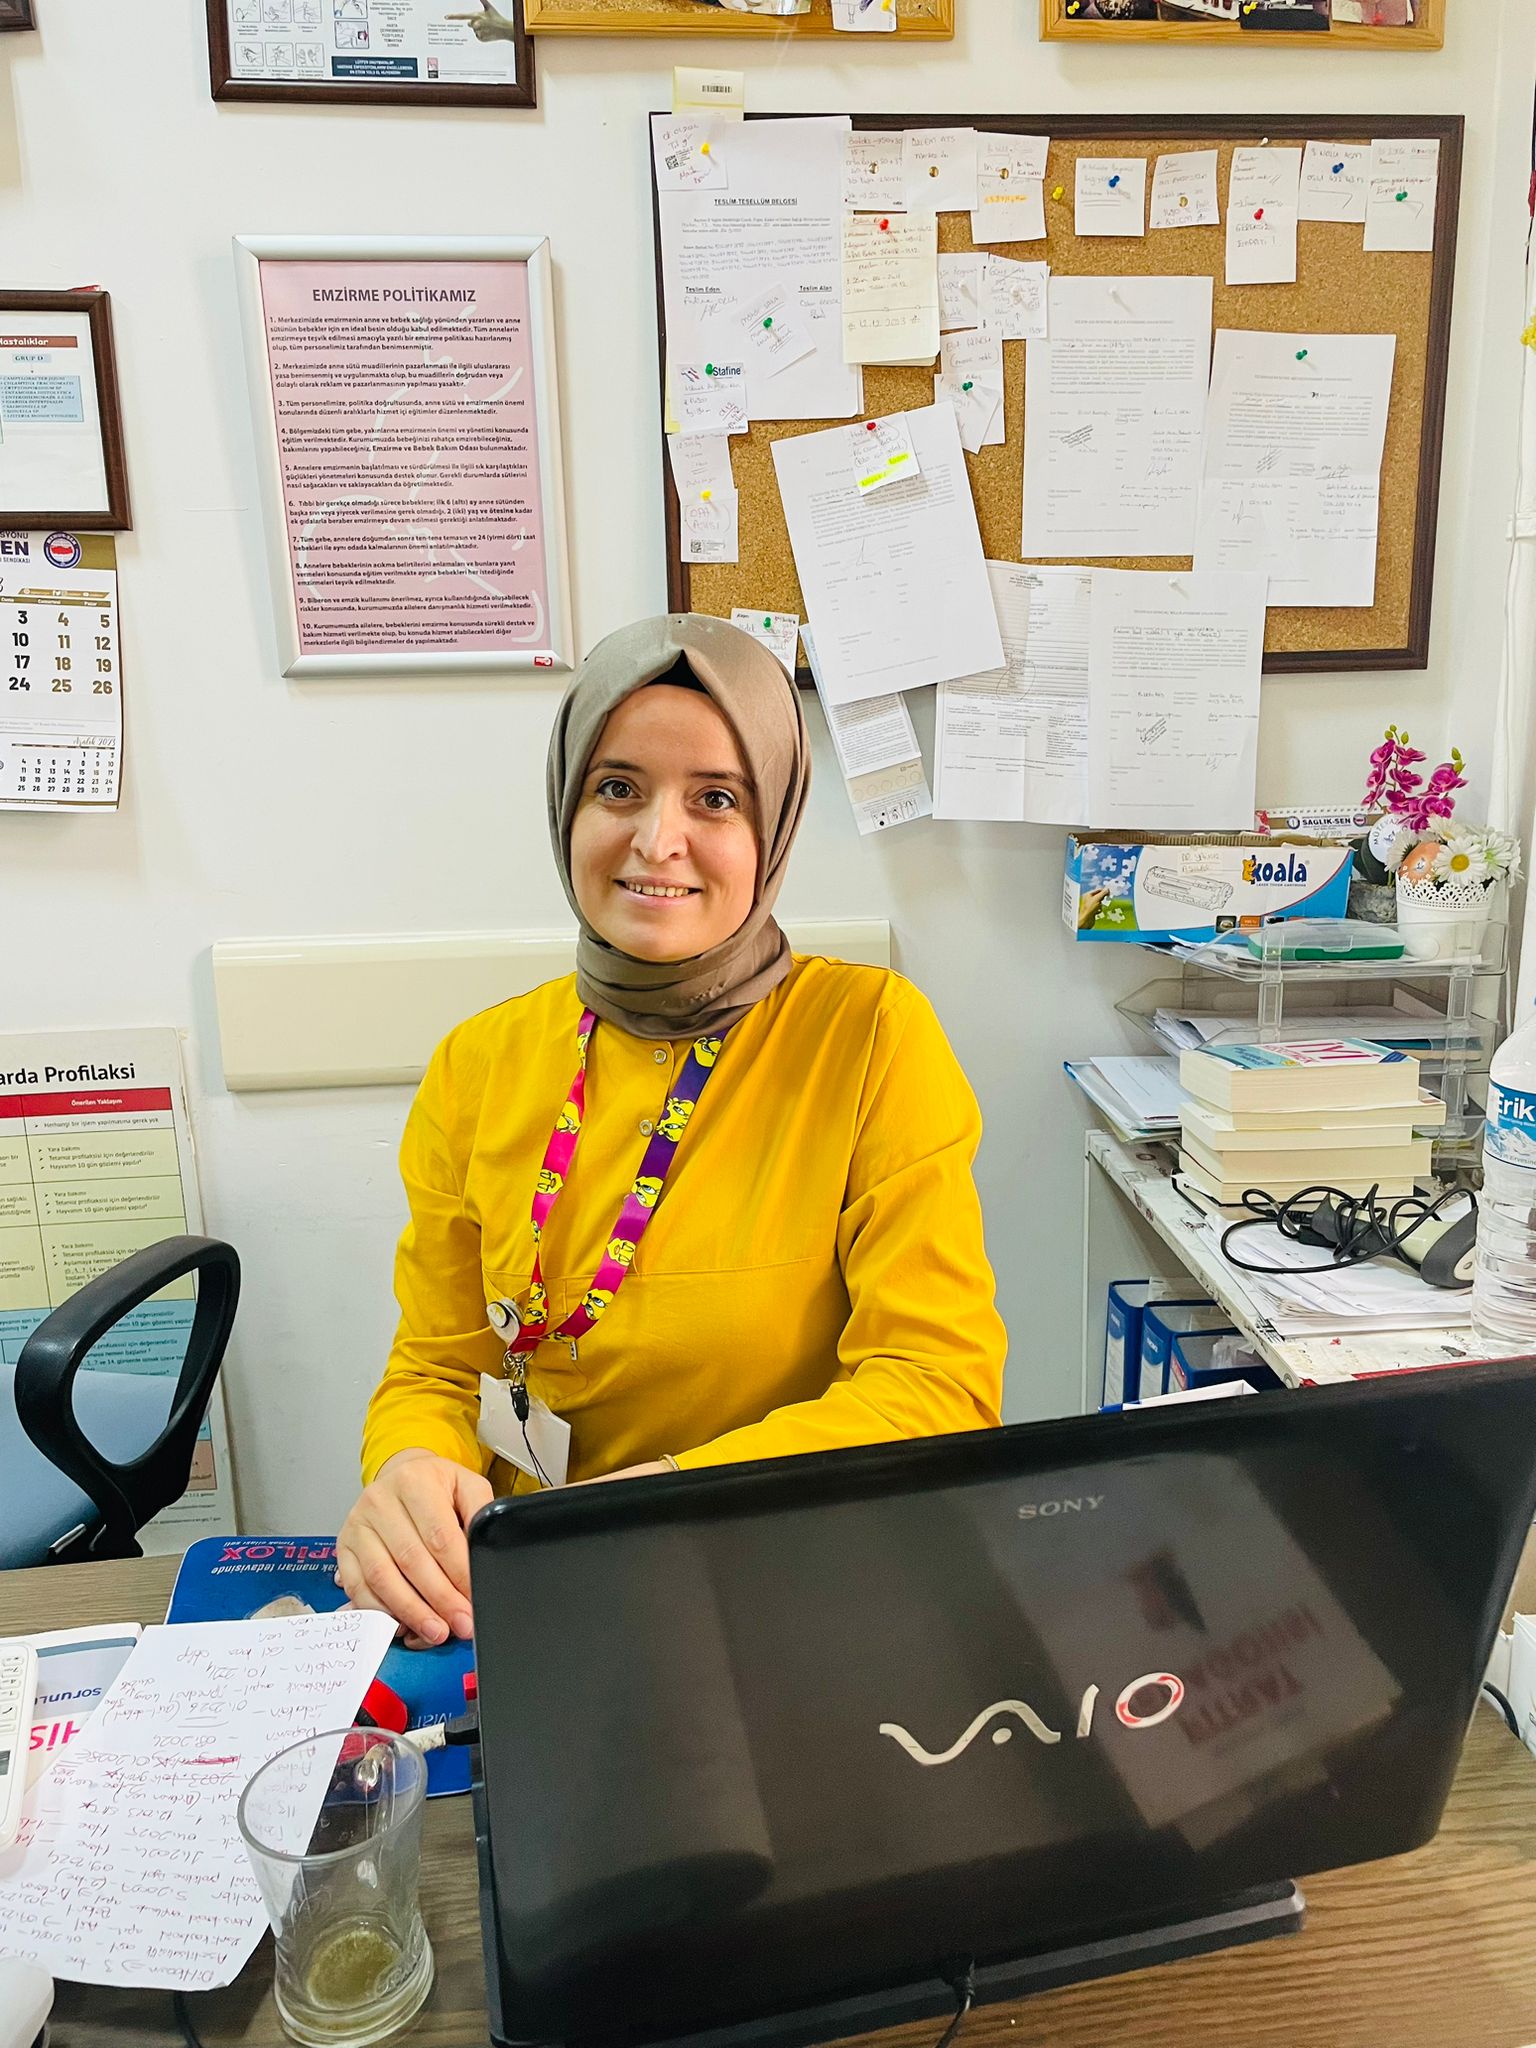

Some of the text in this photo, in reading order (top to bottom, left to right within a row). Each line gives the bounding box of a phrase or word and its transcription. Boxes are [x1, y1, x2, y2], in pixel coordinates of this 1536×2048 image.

[313, 286, 476, 302] EMZİRME POLİTİKAMIZ
[712, 366, 741, 377] Stafine
[18, 610, 110, 628] 3 4 5
[12, 633, 111, 650] 10 11 12
[14, 655, 112, 672] 17 18 19
[9, 677, 113, 695] 24 25 26
[44, 1063, 136, 1082] Profilaksi
[71, 1098, 123, 1107] Önerilen Yaklaşım
[1017, 1495, 1105, 1520] SONY
[218, 1545, 337, 1564] PİLOX
[210, 1563, 275, 1575] tedavisinde
[277, 1563, 320, 1573] mantarı
[879, 1672, 1185, 1766] VAIO
